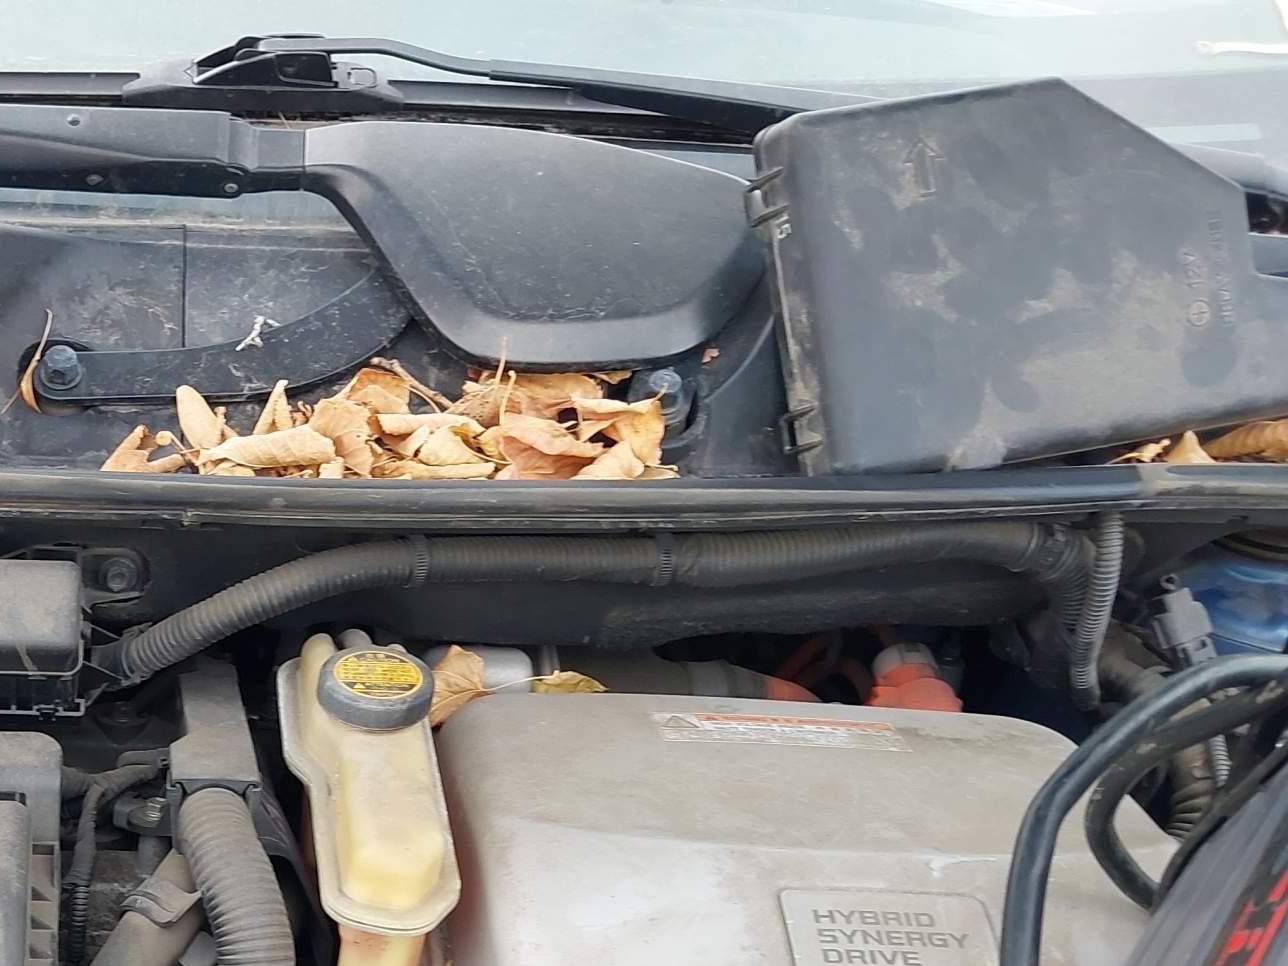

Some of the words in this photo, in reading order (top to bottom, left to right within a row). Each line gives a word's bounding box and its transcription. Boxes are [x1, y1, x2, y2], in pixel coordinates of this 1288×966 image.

[811, 908, 936, 928] HYBRID
[816, 928, 970, 949] SYNERGY
[820, 948, 923, 966] DRIVE
